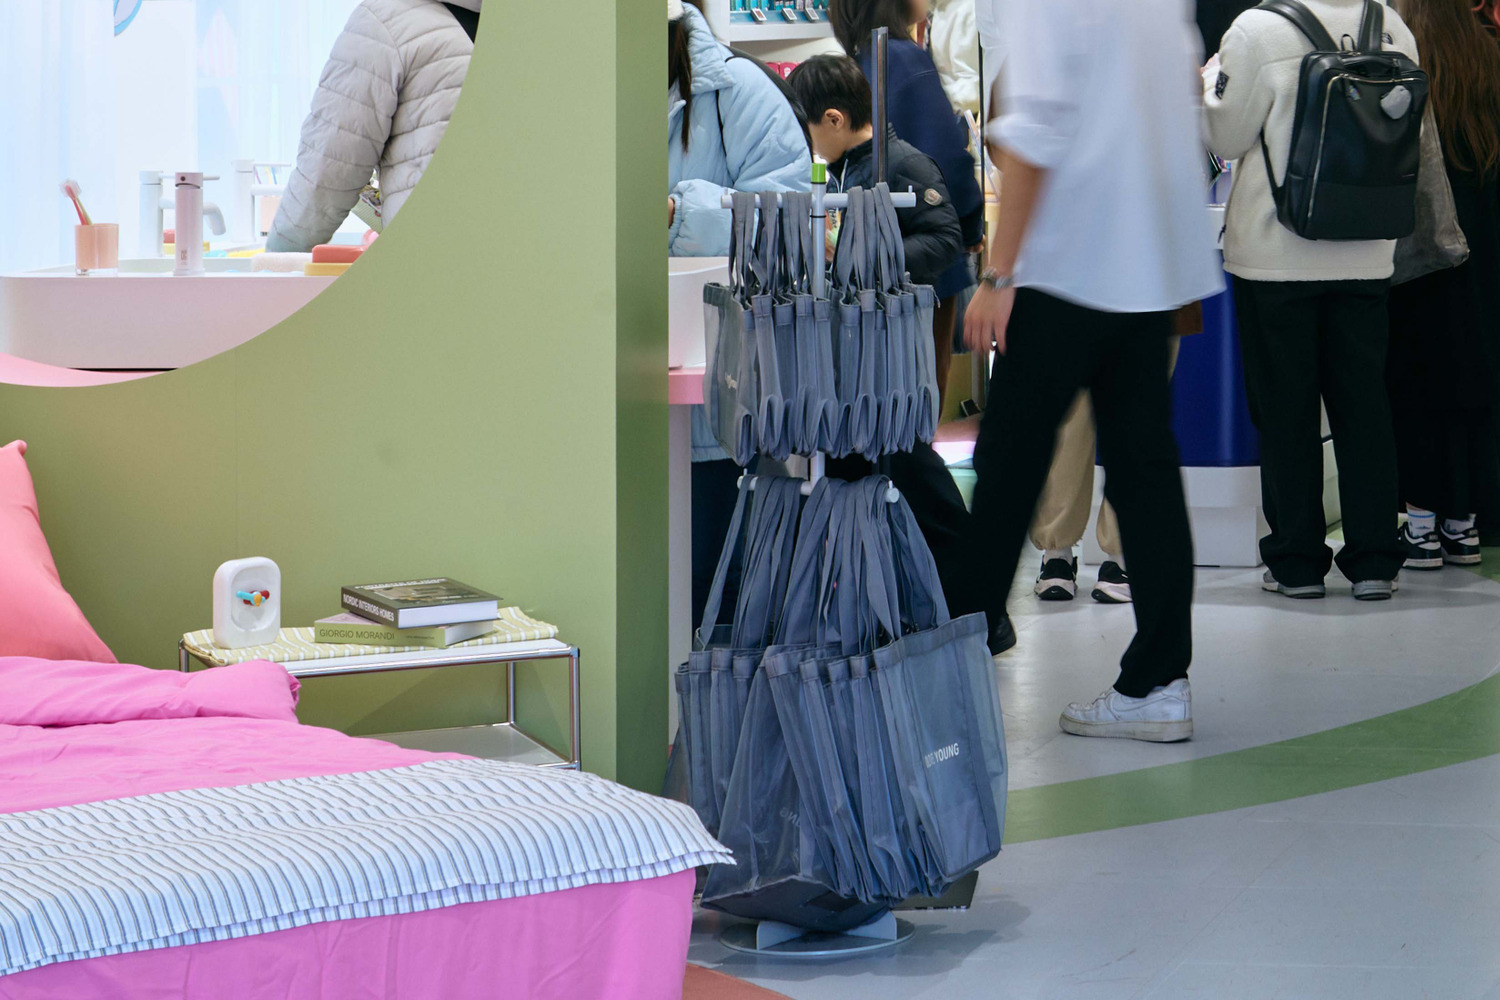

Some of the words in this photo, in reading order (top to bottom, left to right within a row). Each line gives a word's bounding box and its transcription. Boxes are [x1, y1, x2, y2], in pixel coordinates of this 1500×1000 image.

[343, 593, 359, 608] NORDIC
[319, 629, 354, 638] GIORGIO
[355, 631, 395, 640] MORANDI
[933, 742, 960, 763] YOUNG
